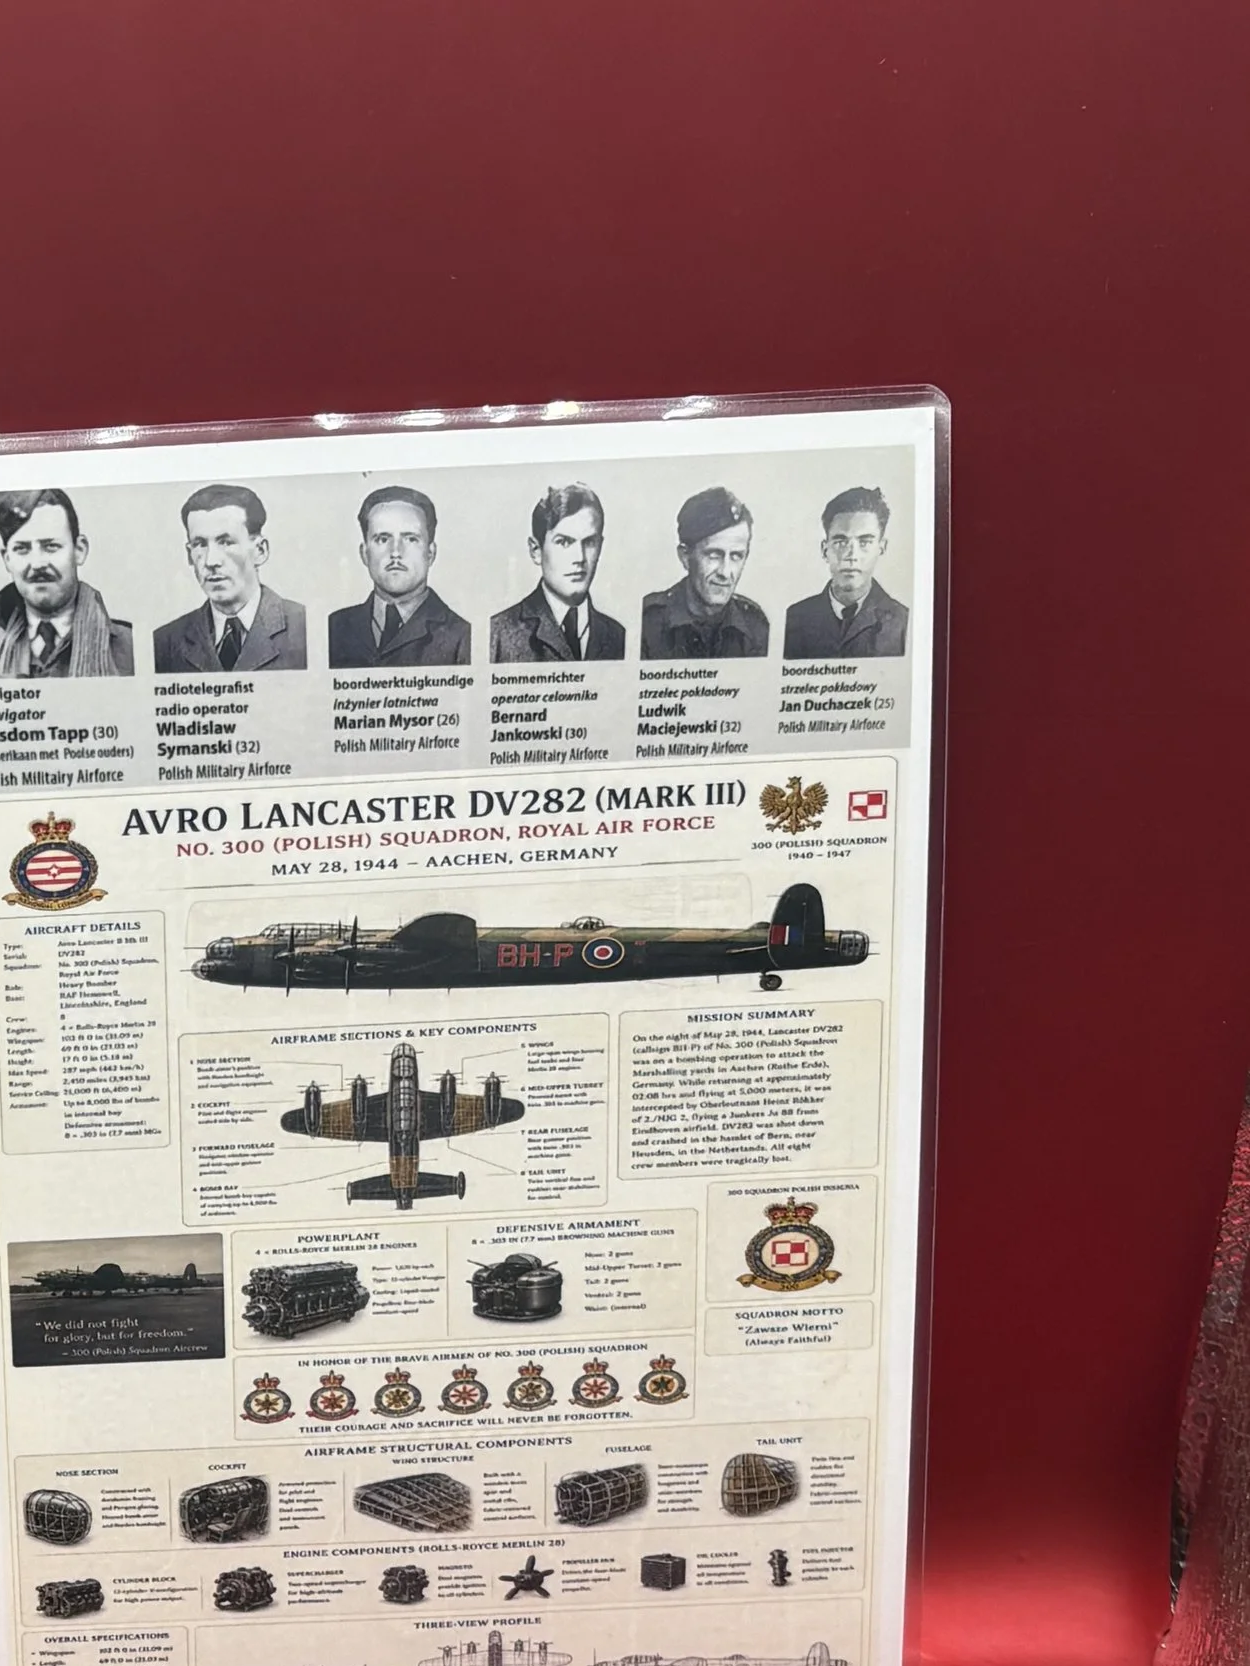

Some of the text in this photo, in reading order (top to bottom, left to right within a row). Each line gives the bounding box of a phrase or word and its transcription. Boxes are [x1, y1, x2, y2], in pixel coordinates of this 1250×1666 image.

[639, 667, 718, 680] boordschutter
[781, 664, 857, 676] boordschutter
[154, 680, 254, 697] radiotelegrafist
[333, 674, 474, 690] boordwerktuigkundige
[155, 703, 248, 717] radio operator
[638, 703, 686, 718] Ludwik
[778, 697, 894, 712] Jan Duchaczek (25)
[334, 713, 459, 730] Marian Mysor (26)
[491, 707, 547, 724] Bernard
[47, 726, 89, 743] Tapp
[92, 725, 118, 740] (30)
[156, 720, 236, 736] Wladislaw
[490, 726, 587, 742] Jankowski (30)
[637, 720, 741, 737] Maciejewski (32)
[157, 739, 260, 760] Symanski (32)
[21, 770, 73, 787] Militairy
[76, 767, 123, 783] Airforce
[121, 779, 745, 836] AVRO LANCASTER DV282 (MARK III)
[177, 815, 715, 857] NO. 300 (POLISH) SQUADRON, ROYAL AIR FORCE
[751, 836, 887, 849] 300 (POLISH) SQUADRON
[271, 862, 311, 876] MAY
[319, 861, 347, 873] 28,
[355, 858, 398, 871] 1944
[425, 852, 513, 867] AACHEN,
[519, 846, 618, 862] GERMANY
[788, 851, 813, 860] 1940
[827, 849, 851, 858] 1947
[24, 921, 141, 935] AIRCRAFT DETAILS
[497, 943, 574, 967] BH-P
[687, 1008, 815, 1022] MISSION SUMMARY
[270, 1023, 537, 1044] AIRFRAME SECTIONS & KEY COMPONENTS
[496, 1218, 640, 1233] DEFENSIVE ARMAMENT
[297, 1232, 380, 1243] POWERPLANT
[735, 1307, 843, 1320] SQUADRON MOTTO
[304, 1436, 572, 1456] AIRFRAME STRUCTURAL COMPONENTS
[413, 1617, 541, 1629] THREE-VIEW PROFILE
